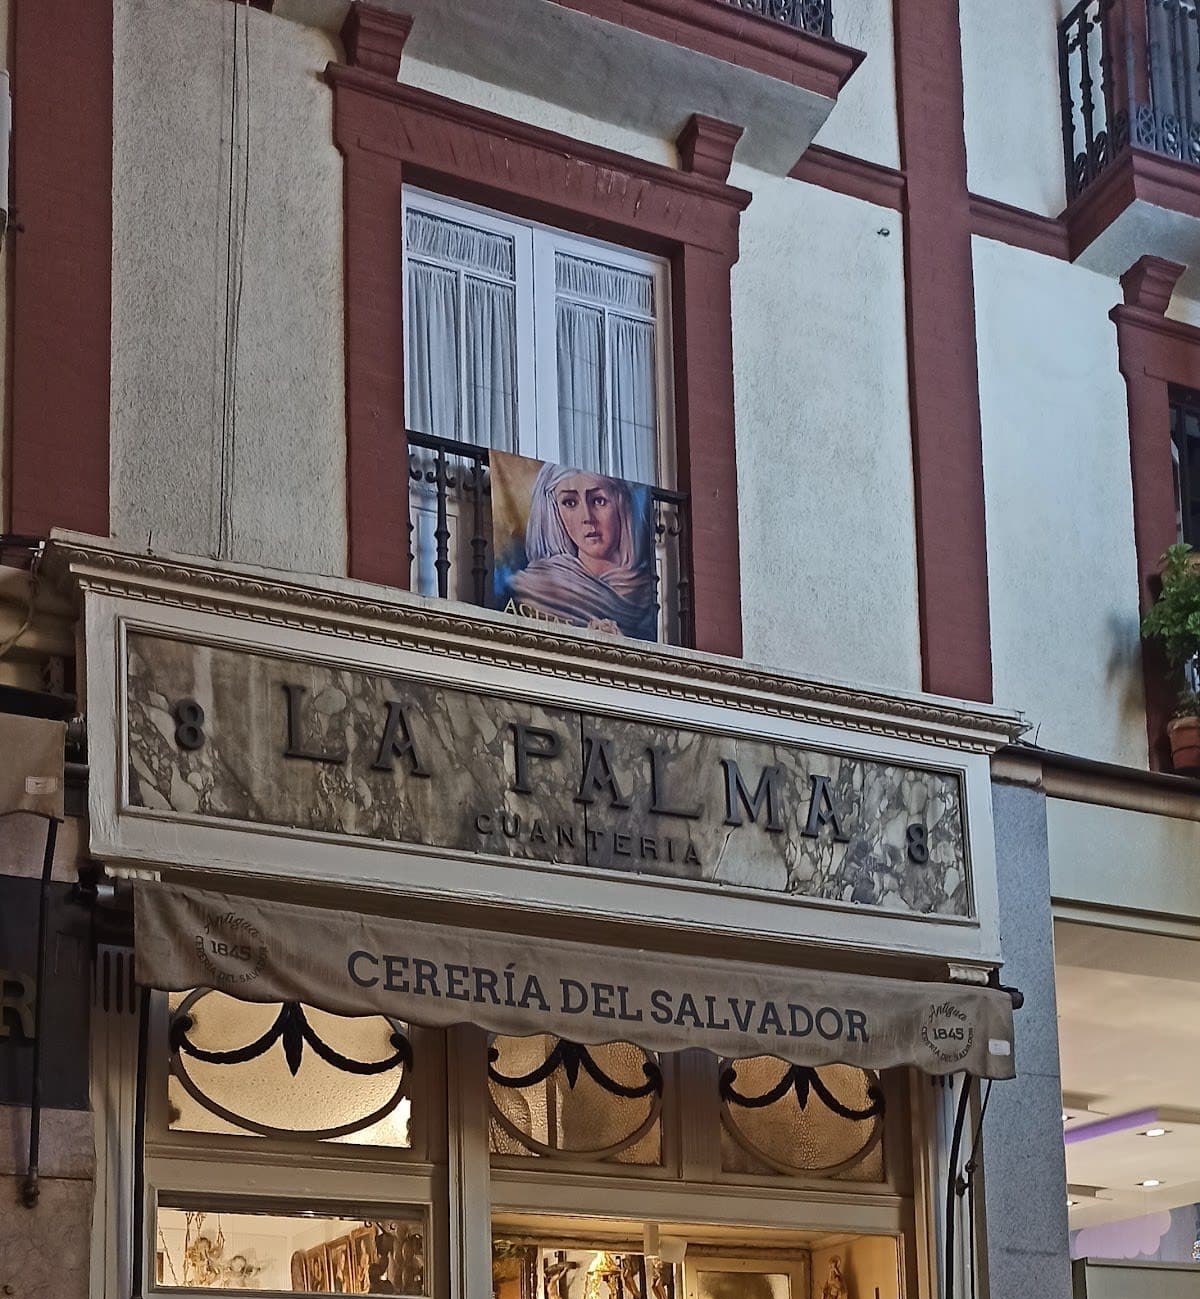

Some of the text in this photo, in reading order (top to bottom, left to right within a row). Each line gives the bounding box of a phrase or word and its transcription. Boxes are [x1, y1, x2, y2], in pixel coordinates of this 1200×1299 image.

[175, 684, 928, 865] 8 LA PALMA 8
[210, 940, 251, 961] 1845
[347, 950, 870, 1043] CERERÍA DEL SALVADOR
[934, 1027, 964, 1040] 1845
